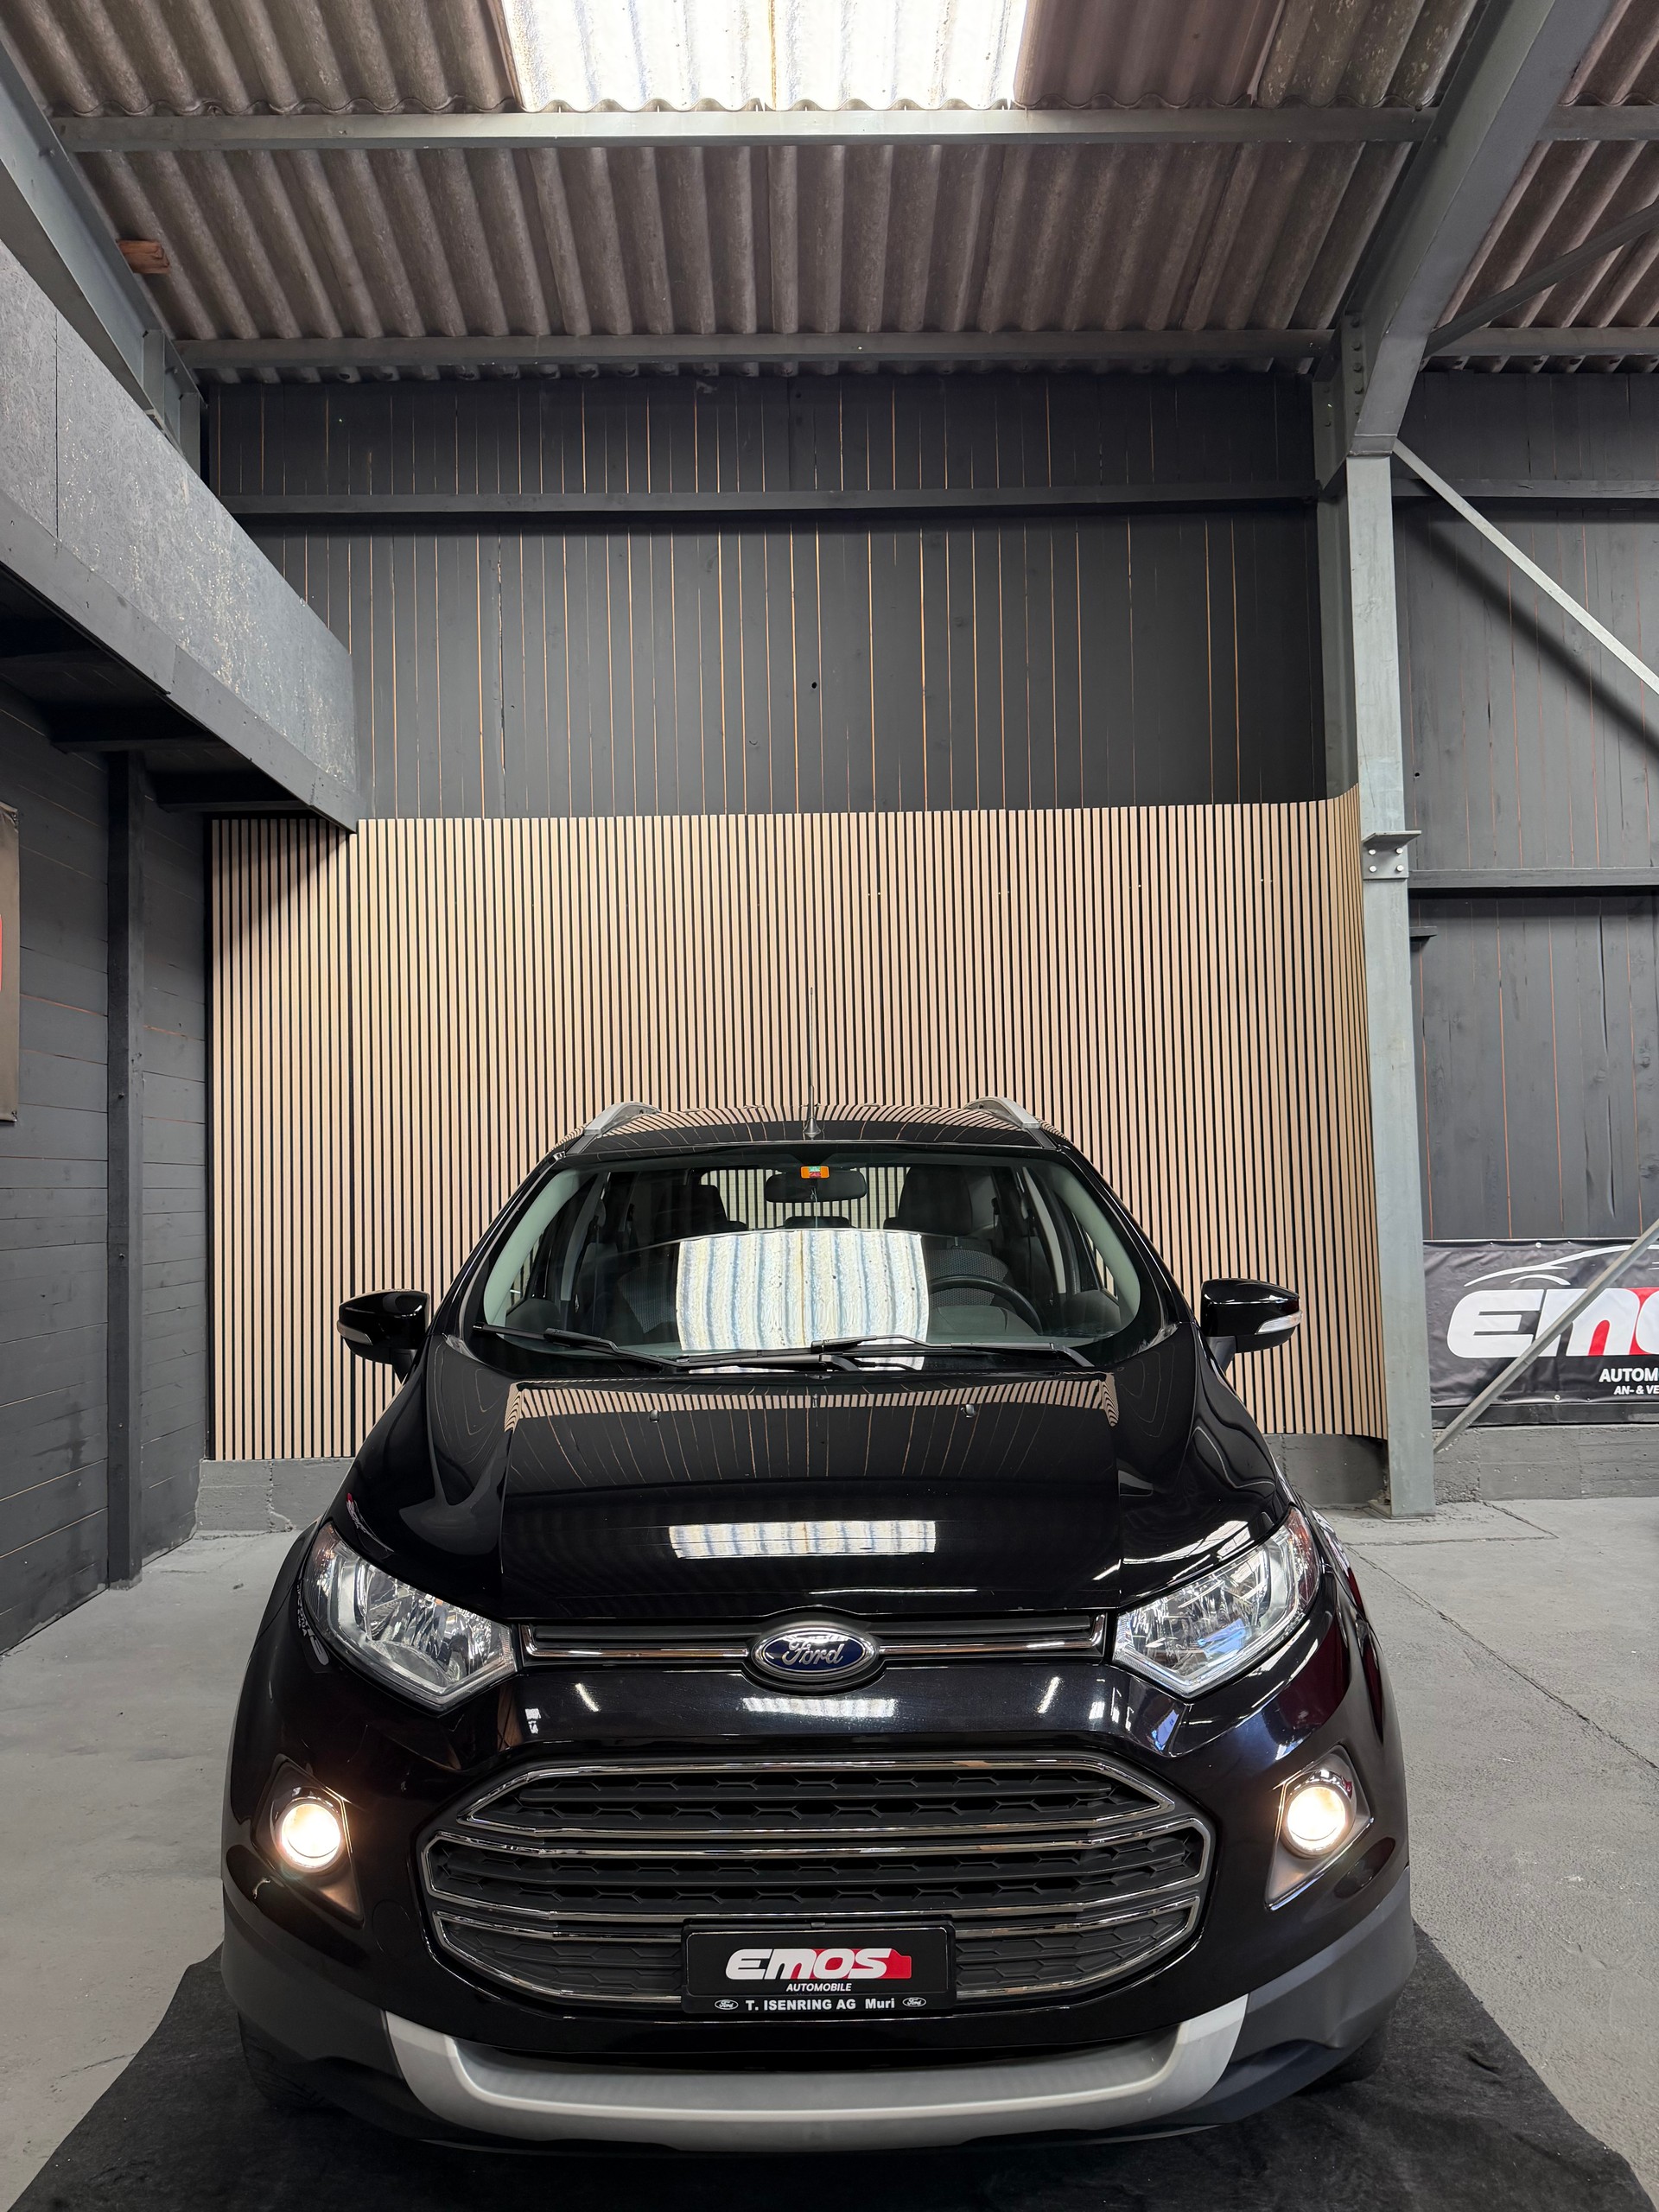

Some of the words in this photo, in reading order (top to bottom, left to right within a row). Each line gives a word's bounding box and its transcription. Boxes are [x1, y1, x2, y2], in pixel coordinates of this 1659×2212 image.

[1446, 1287, 1659, 1357] EM
[1599, 1368, 1659, 1382] AUTOM
[1613, 1385, 1635, 1395] AN-
[1636, 1385, 1644, 1395] &
[782, 1637, 845, 1665] Ford
[725, 1948, 893, 1980] EMOS
[785, 1983, 852, 1992] AUTOMOBILE
[745, 1999, 760, 2011] T.
[764, 1999, 832, 2011] ISENRING
[836, 1999, 856, 2010] AG
[865, 1998, 895, 2009] Muri
